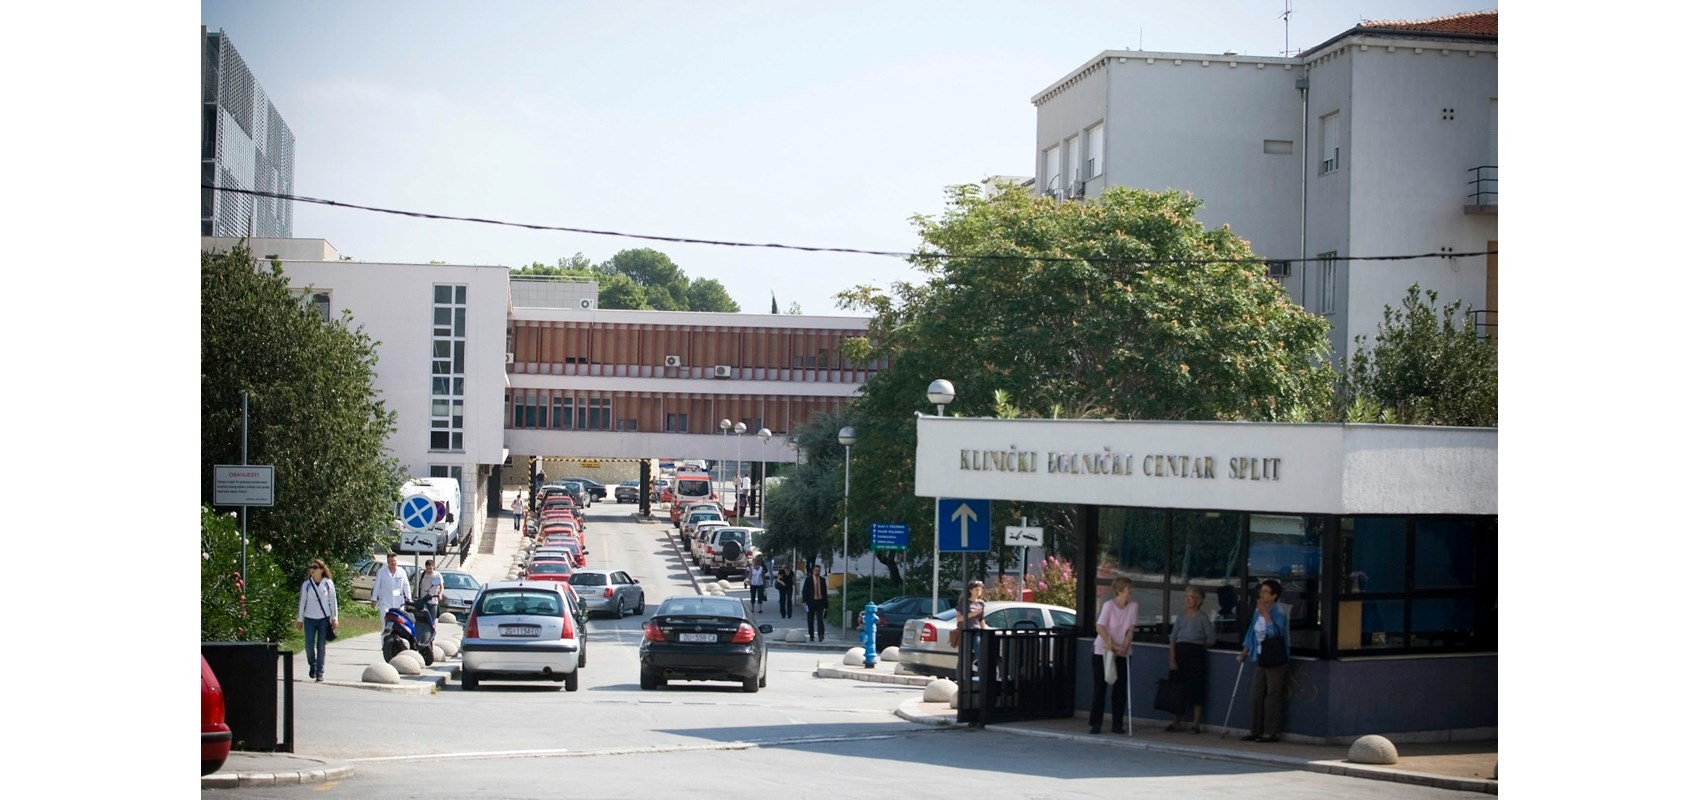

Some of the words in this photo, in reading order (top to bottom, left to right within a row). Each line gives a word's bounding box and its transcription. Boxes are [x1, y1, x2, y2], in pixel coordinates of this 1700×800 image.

[960, 443, 1037, 473] KLINIČKI
[1142, 454, 1215, 479] CENTAR
[1228, 456, 1281, 481] SPLIT
